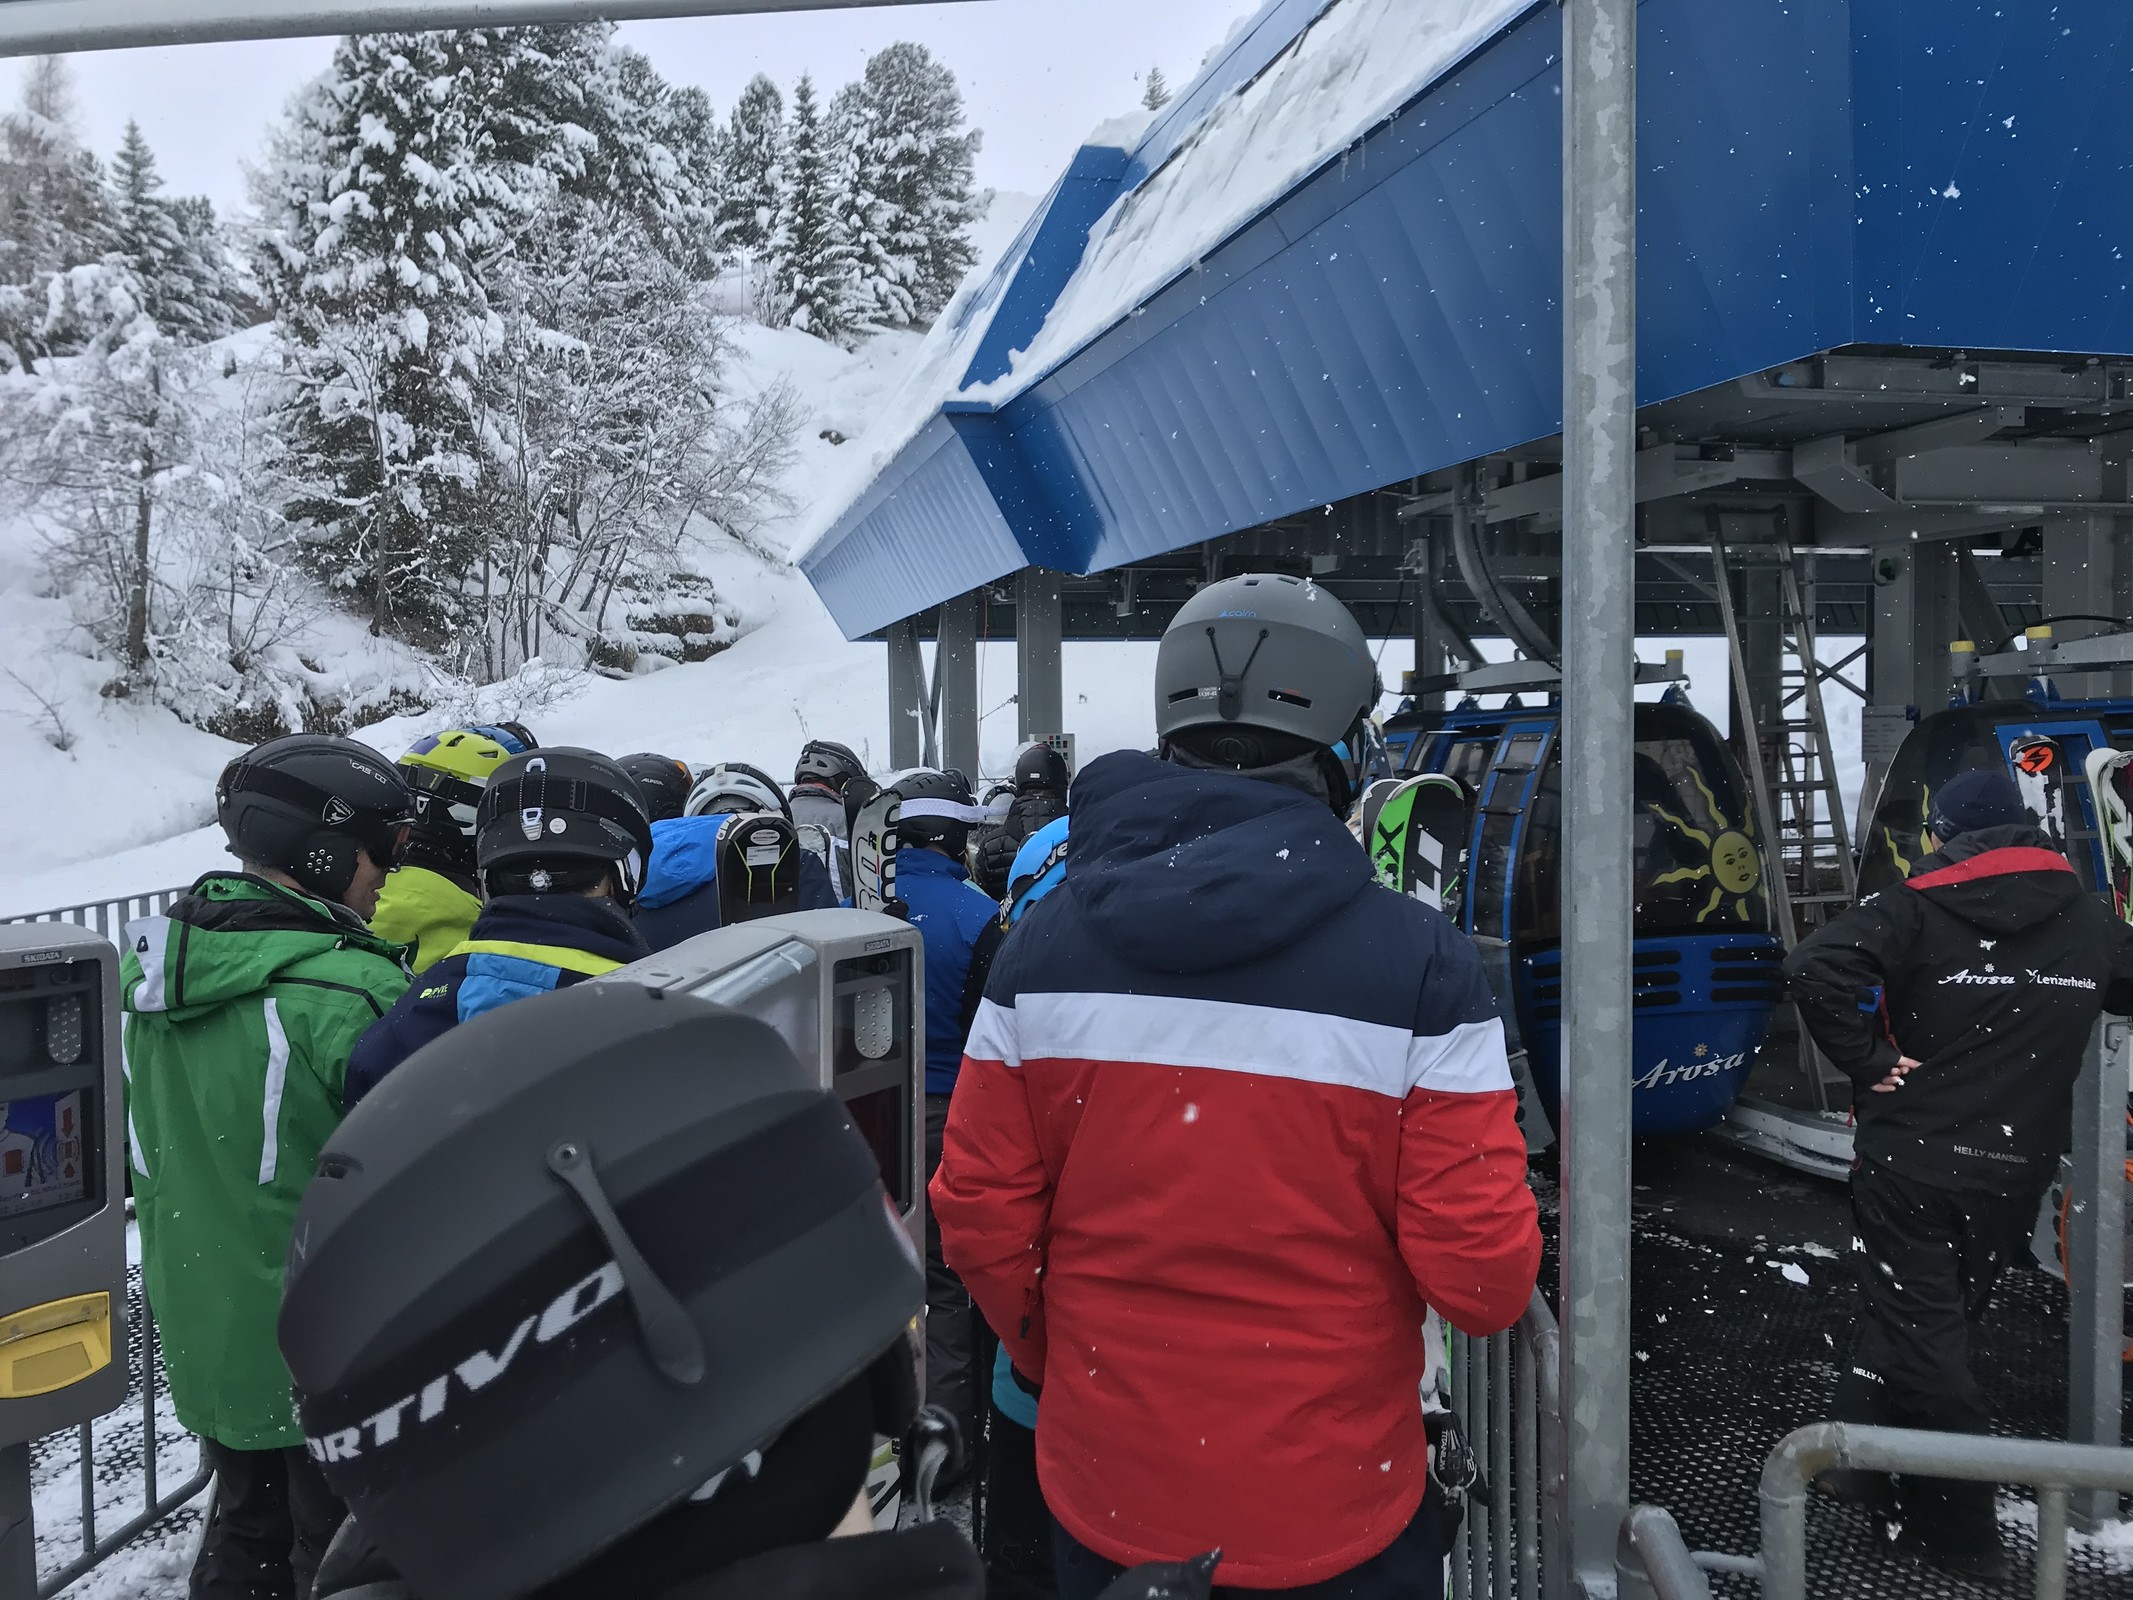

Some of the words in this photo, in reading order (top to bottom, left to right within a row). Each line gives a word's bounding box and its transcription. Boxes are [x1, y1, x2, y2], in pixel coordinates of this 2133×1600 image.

[23, 951, 61, 963] SKIDATA
[1937, 968, 2016, 985] Arosa
[2036, 973, 2098, 990] Lenzerheide
[1632, 1052, 1746, 1089] Arosa
[1953, 1144, 1986, 1157] HELLY
[1852, 1366, 1878, 1380] HELLY
